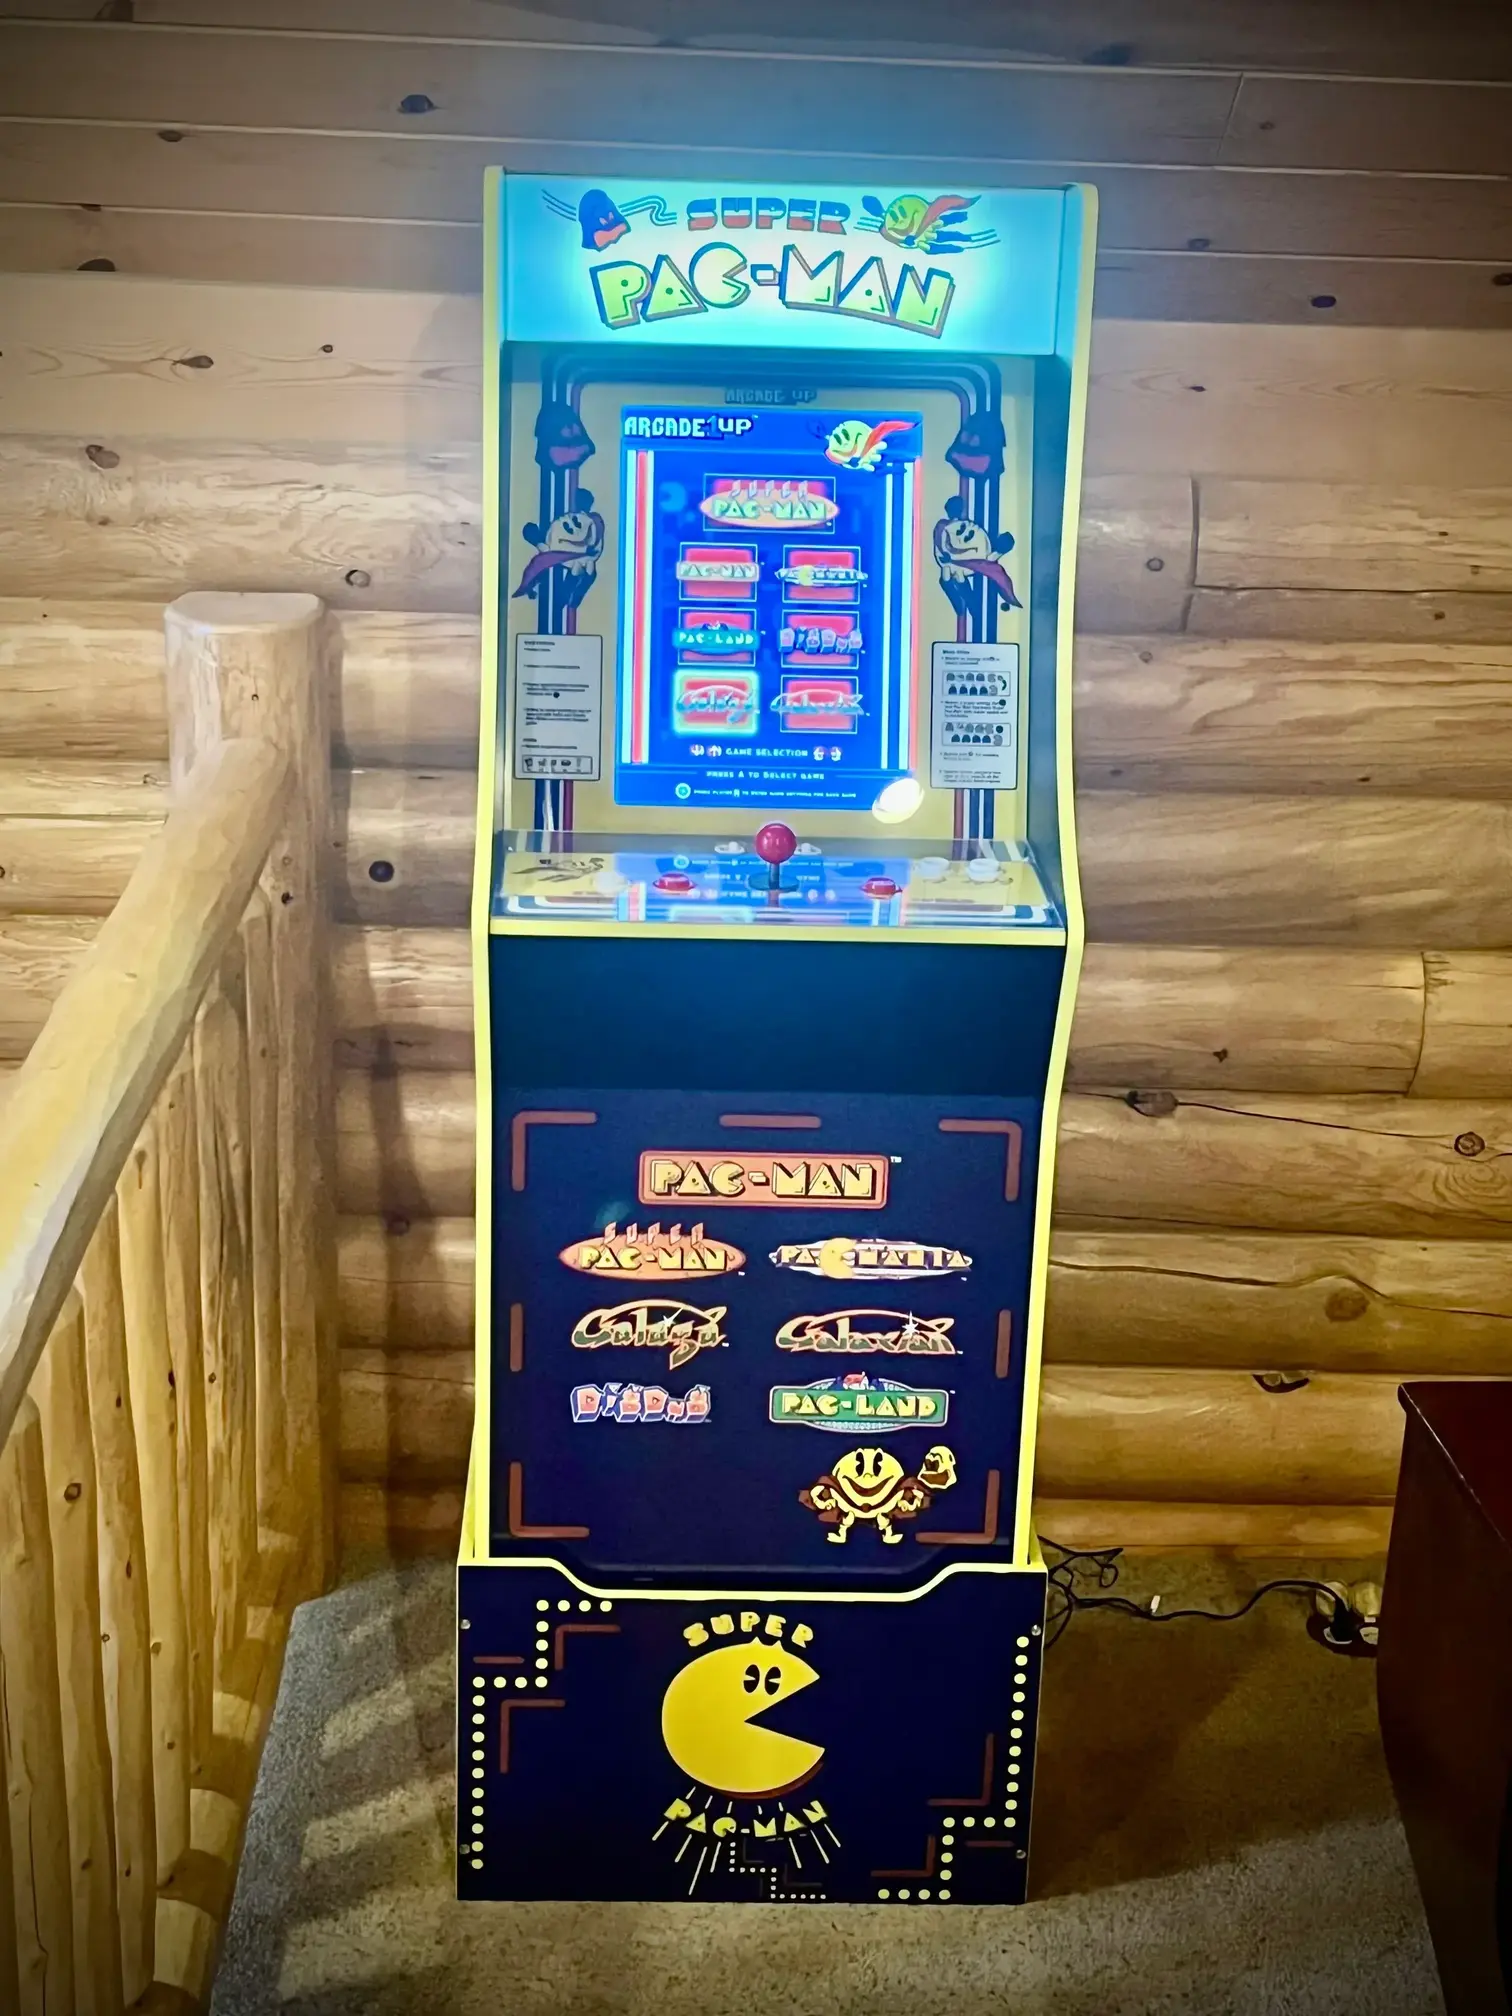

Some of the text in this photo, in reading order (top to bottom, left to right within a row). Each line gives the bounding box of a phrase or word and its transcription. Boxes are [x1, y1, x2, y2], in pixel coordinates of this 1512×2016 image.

[687, 196, 851, 236] SUPER
[589, 241, 956, 339] PAC-MAN
[713, 499, 826, 520] PAC-MAN
[725, 747, 808, 757] GAME SELECTION
[650, 1160, 878, 1198] PAC-MAN
[603, 1222, 704, 1249] SUPER
[578, 1245, 727, 1271] PAC-MAN
[782, 1392, 938, 1419] PAC-LAND
[683, 1612, 814, 1648] SUPER
[664, 1798, 828, 1838] PAC-MAN
